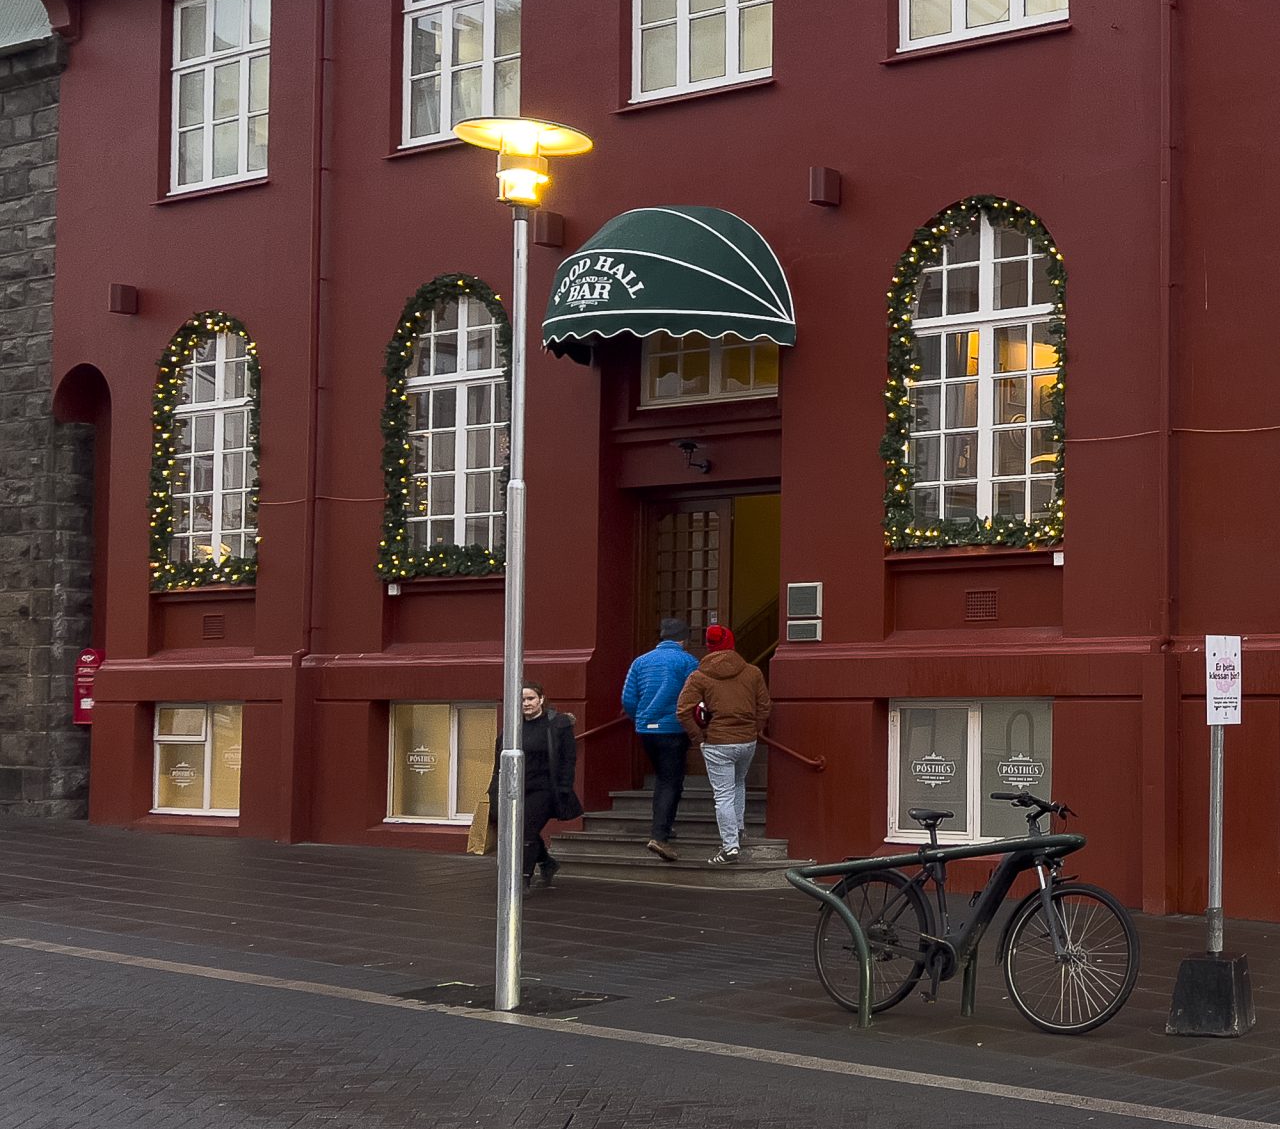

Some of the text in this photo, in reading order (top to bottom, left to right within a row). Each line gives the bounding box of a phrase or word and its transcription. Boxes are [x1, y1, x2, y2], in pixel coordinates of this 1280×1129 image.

[593, 255, 645, 299] HALL
[566, 283, 611, 302] BAR
[916, 763, 951, 773] PÓSTHÚS
[1002, 764, 1039, 774] PÓSTHÚS
